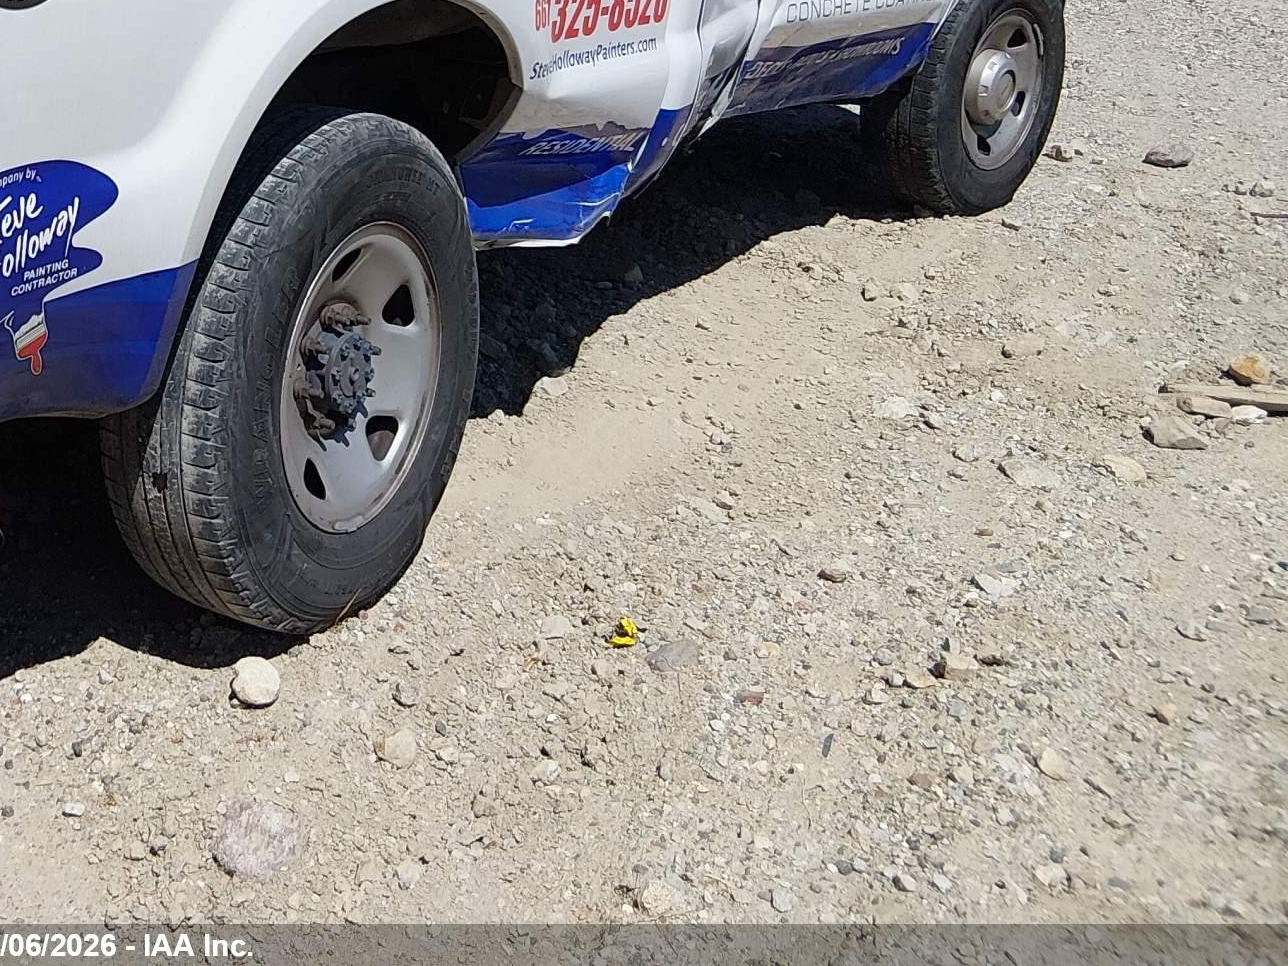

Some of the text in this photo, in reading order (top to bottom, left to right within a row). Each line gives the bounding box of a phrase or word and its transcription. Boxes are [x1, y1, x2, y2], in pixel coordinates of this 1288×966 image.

[518, 131, 645, 155] RESIDENTIAL
[11, 268, 78, 296] CONTRACTOR
[24, 259, 69, 281] PAINTING
